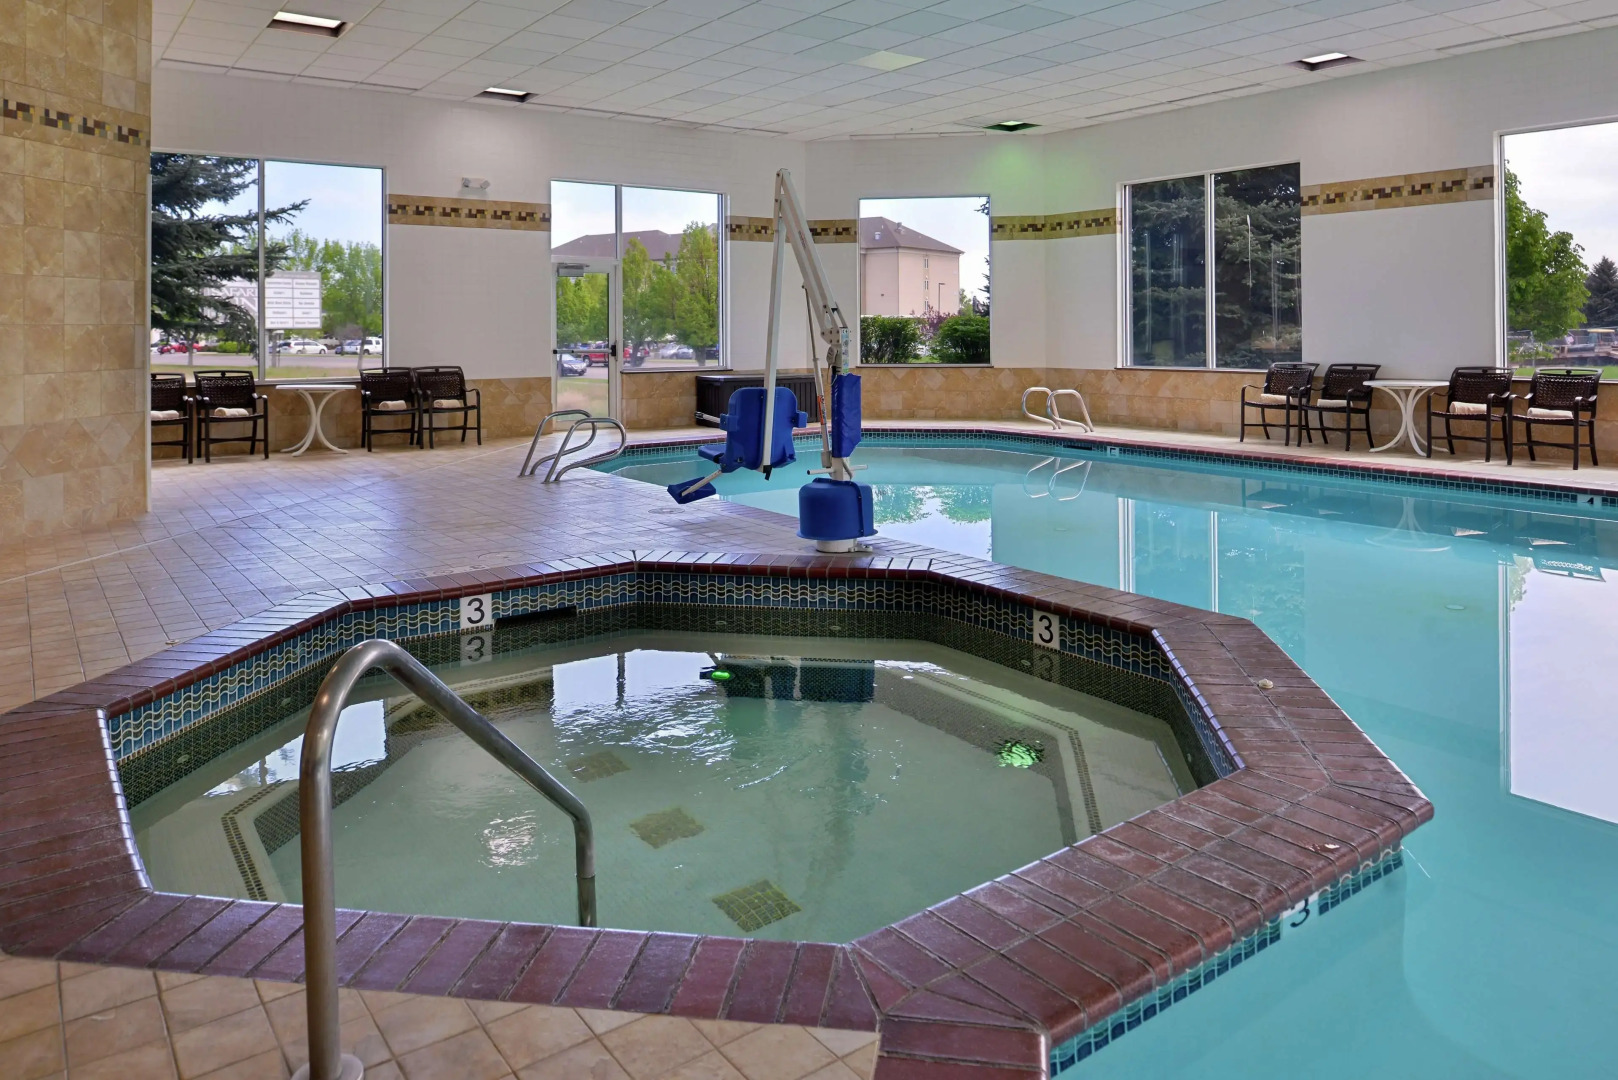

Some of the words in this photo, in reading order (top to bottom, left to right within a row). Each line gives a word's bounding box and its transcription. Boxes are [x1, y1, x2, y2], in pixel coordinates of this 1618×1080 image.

[467, 597, 485, 624] 3
[1038, 614, 1053, 643] 3
[1290, 897, 1310, 928] 3
